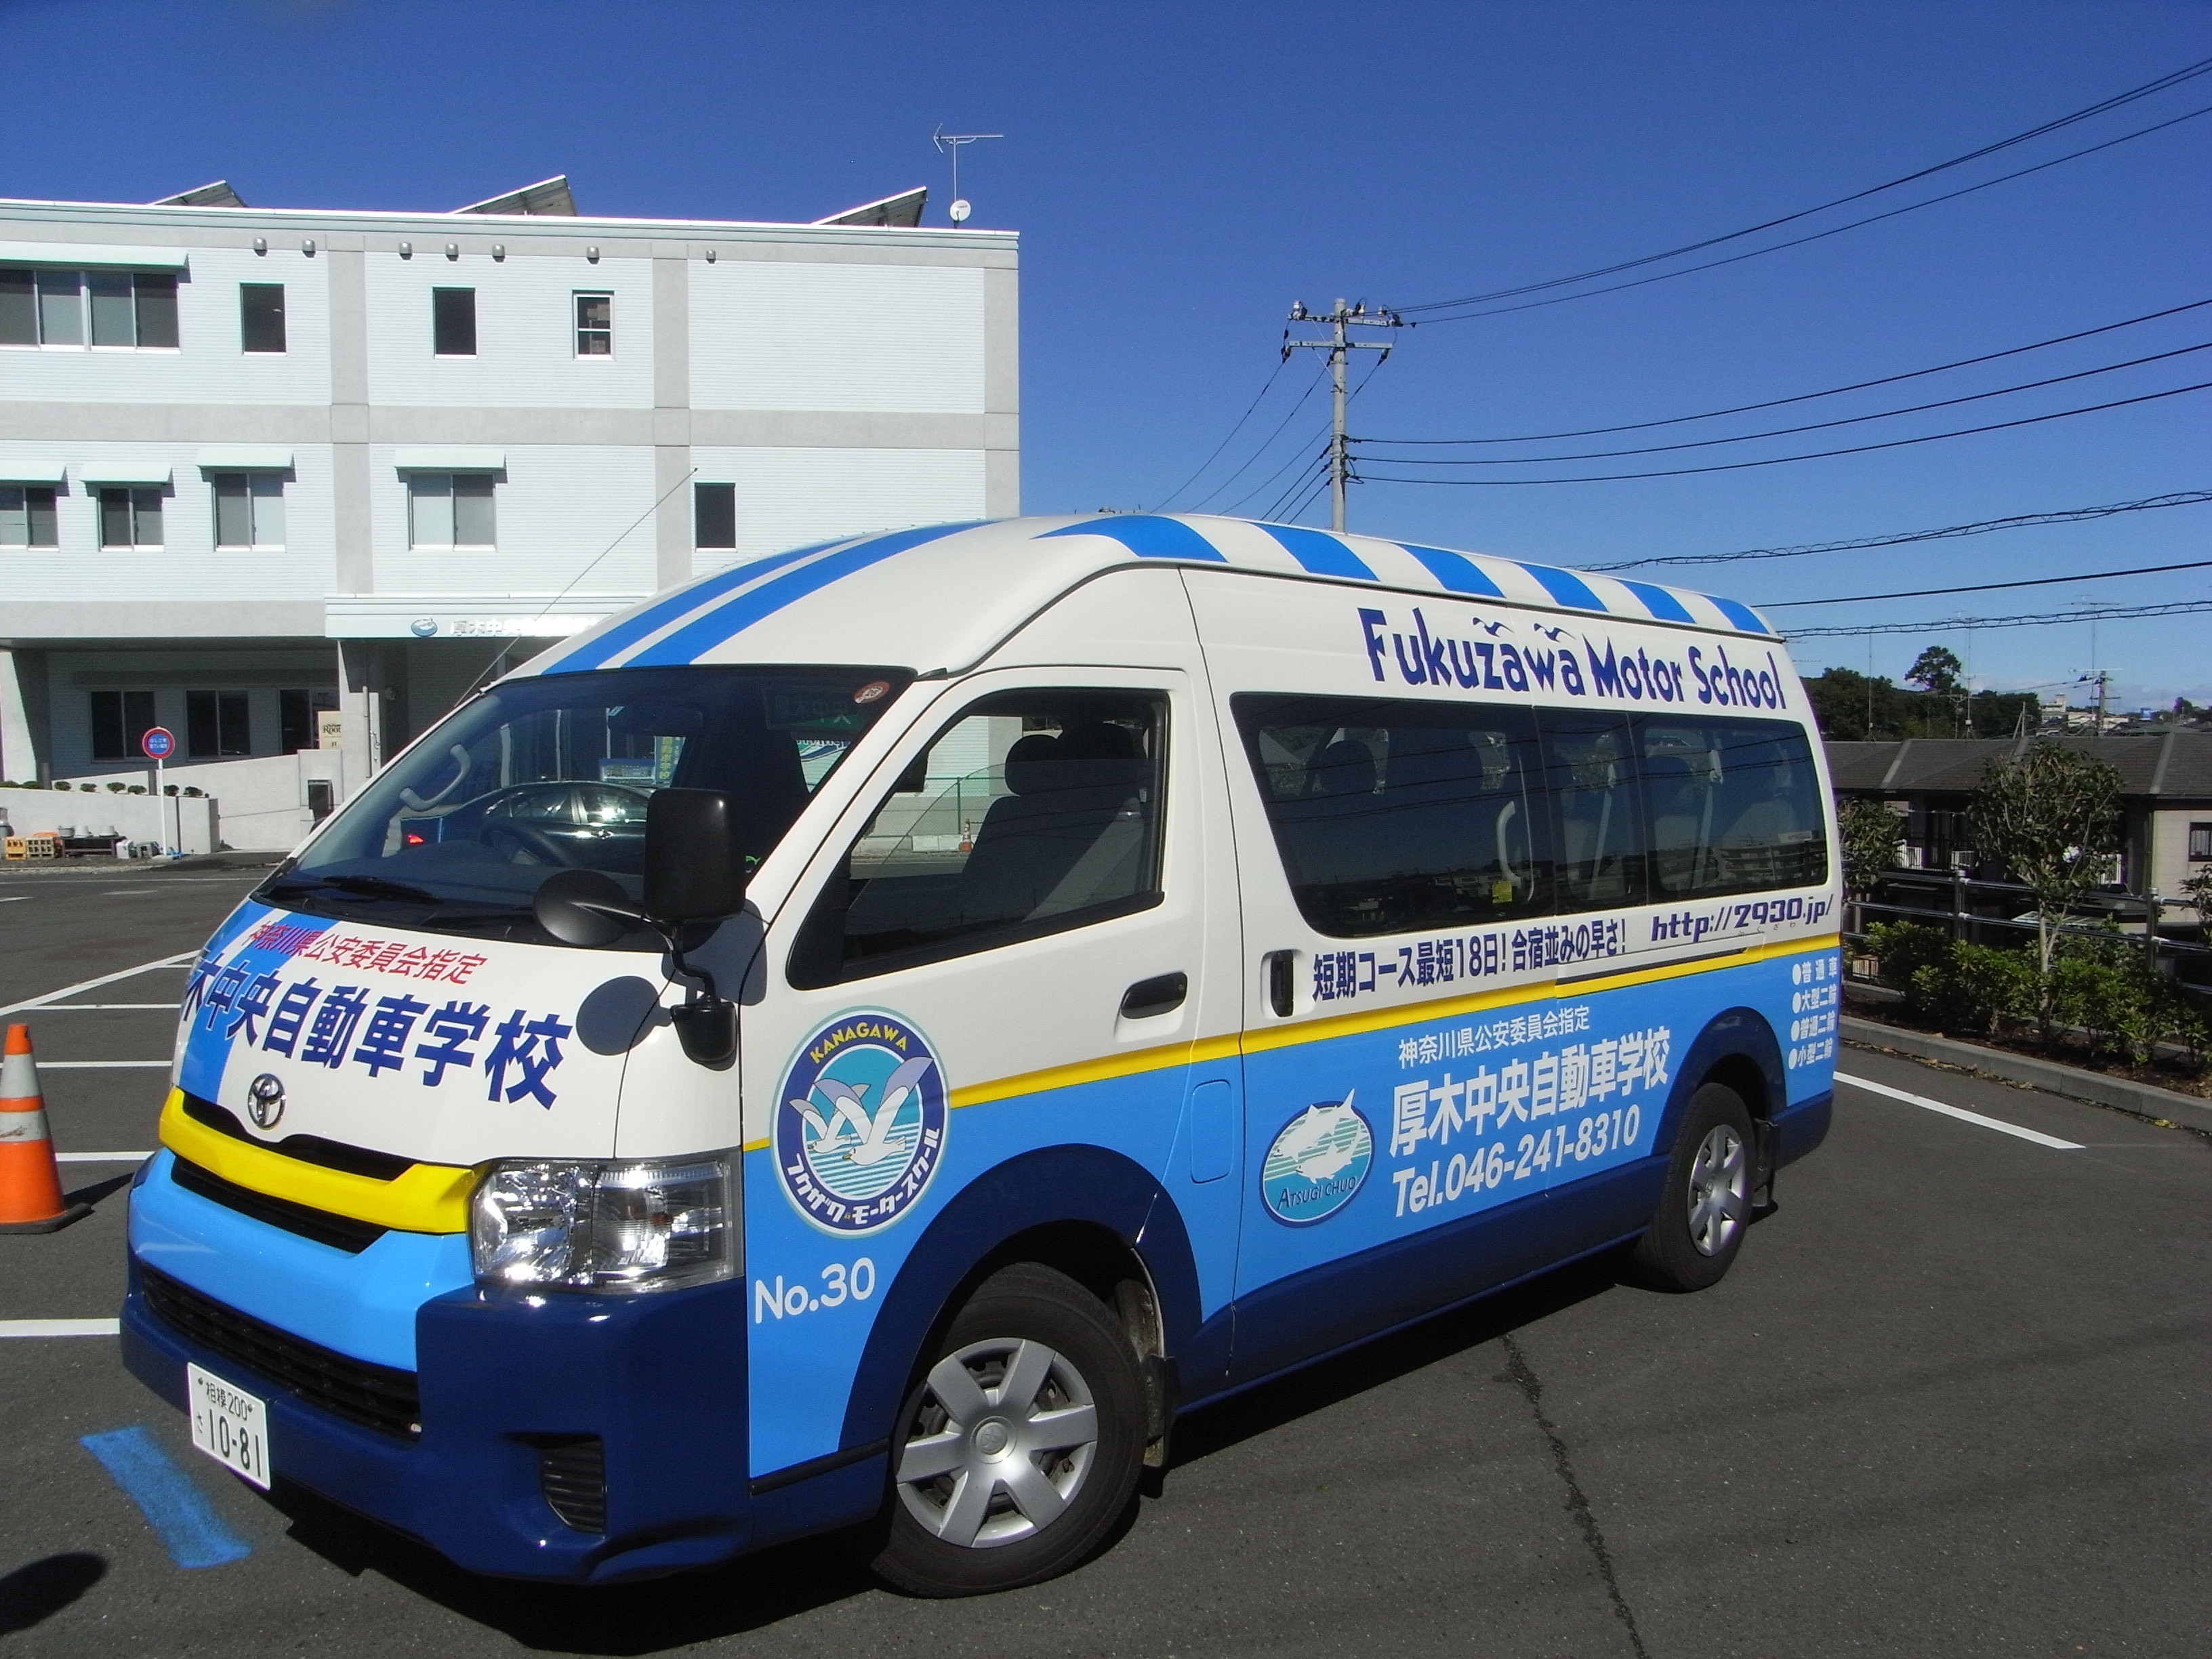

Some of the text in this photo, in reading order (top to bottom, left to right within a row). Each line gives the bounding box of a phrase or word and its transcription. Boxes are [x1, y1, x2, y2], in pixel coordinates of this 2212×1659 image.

[1357, 607, 1786, 710] Fukuzawa Motor School
[1650, 894, 1834, 943] http://2930.jp/
[241, 920, 489, 985] 神奈川県公安委員会指定
[809, 1021, 907, 1064] KANAGAWA
[1397, 1005, 1590, 1069] 神奈川県公安委員会指定
[1389, 1025, 1671, 1158] 厚木中央自動車学校
[1325, 1176, 1357, 1197] CHUO
[1391, 1103, 1641, 1218] Tel.046-241-8310
[754, 1256, 876, 1324] No.30
[209, 1408, 262, 1478] 10-81
